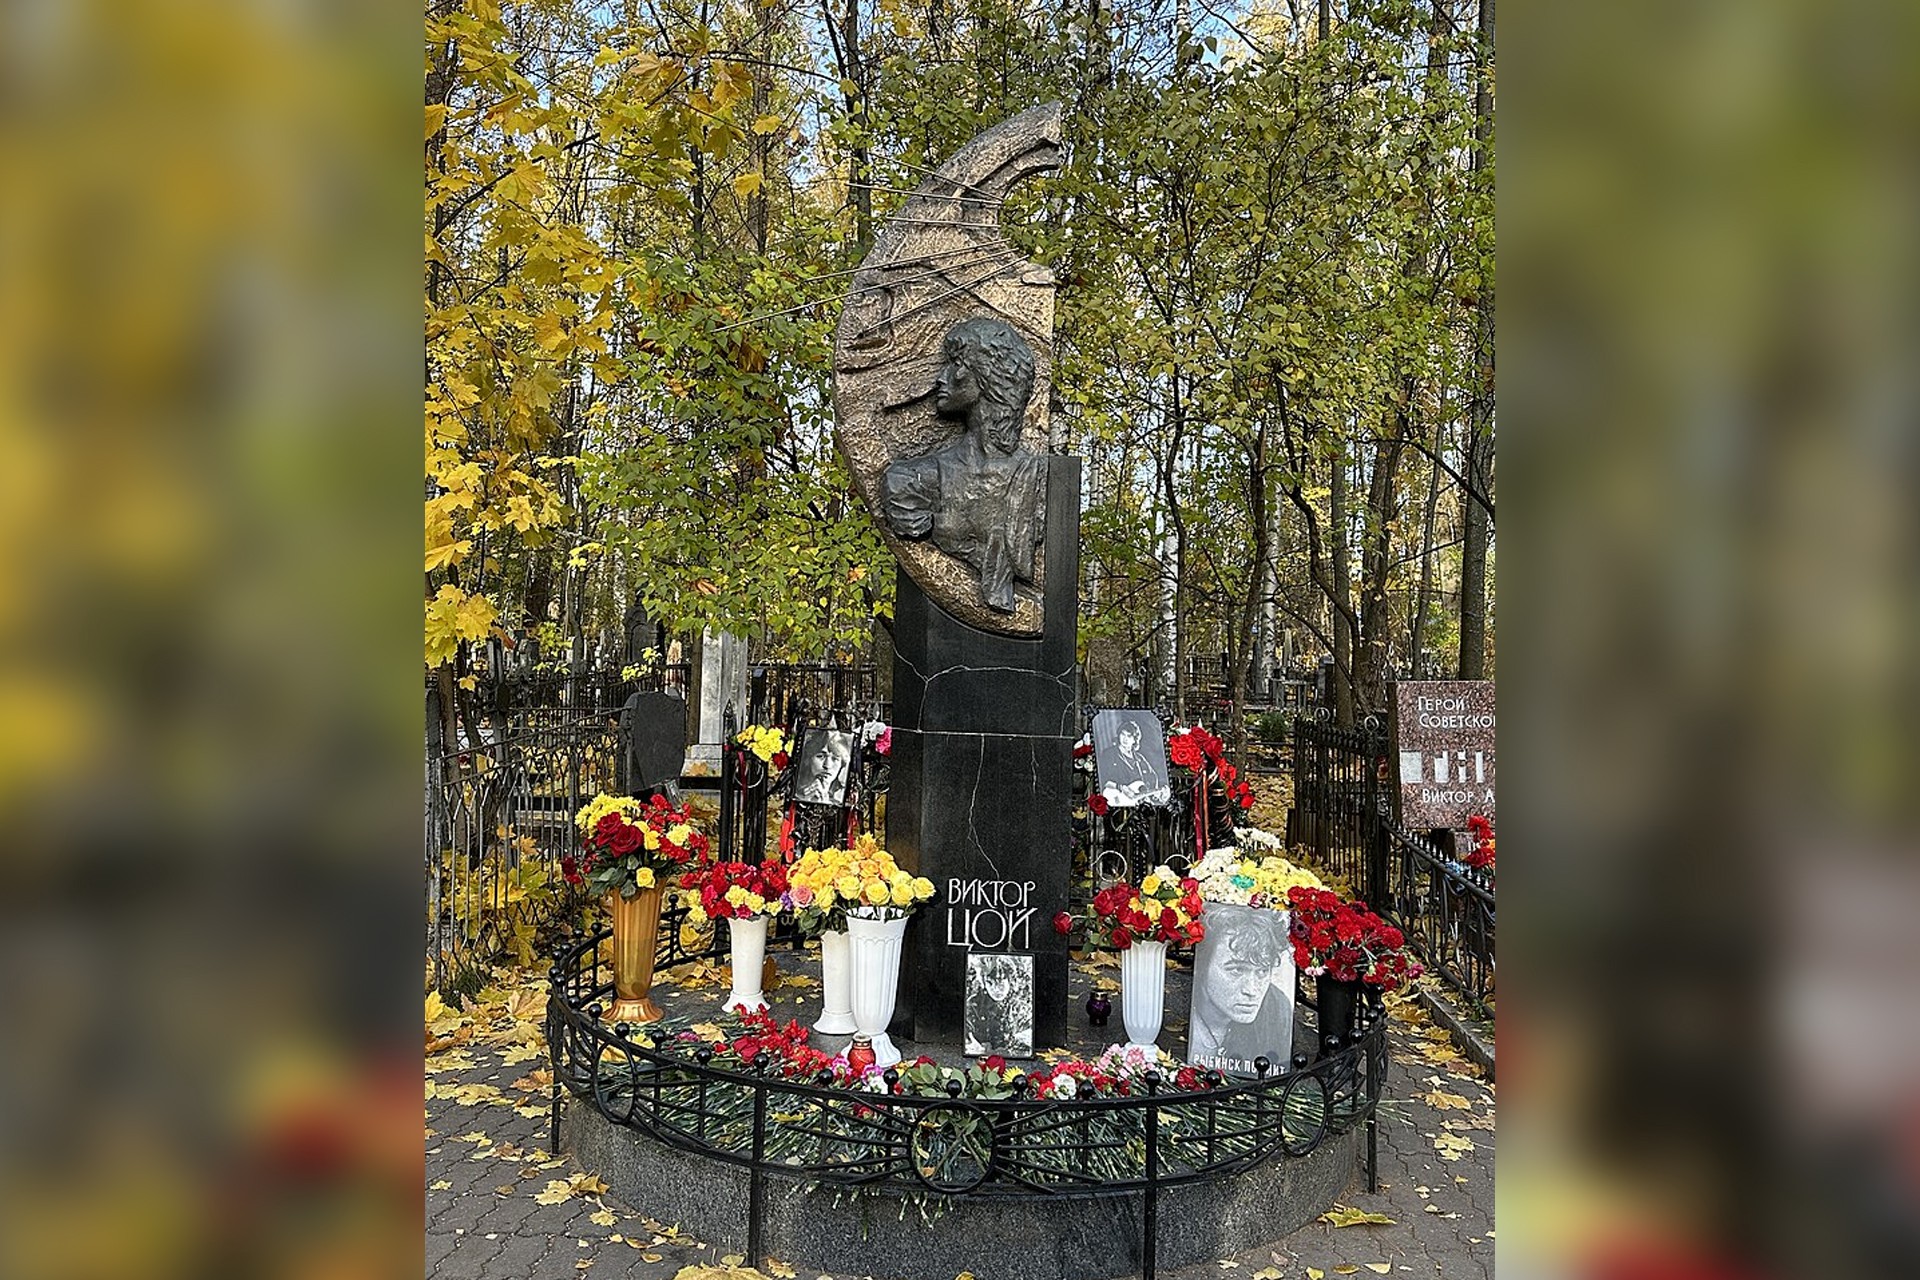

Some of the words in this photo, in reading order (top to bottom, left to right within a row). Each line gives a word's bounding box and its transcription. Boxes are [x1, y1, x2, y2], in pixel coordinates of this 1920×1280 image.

[1422, 788, 1474, 803] ВИКТОР
[948, 878, 1036, 908] ВИКТОР
[947, 907, 1038, 952] ЦОЙ
[1193, 1054, 1241, 1072] РЫБИНСК
[1244, 1060, 1286, 1076] ПОНИТ
